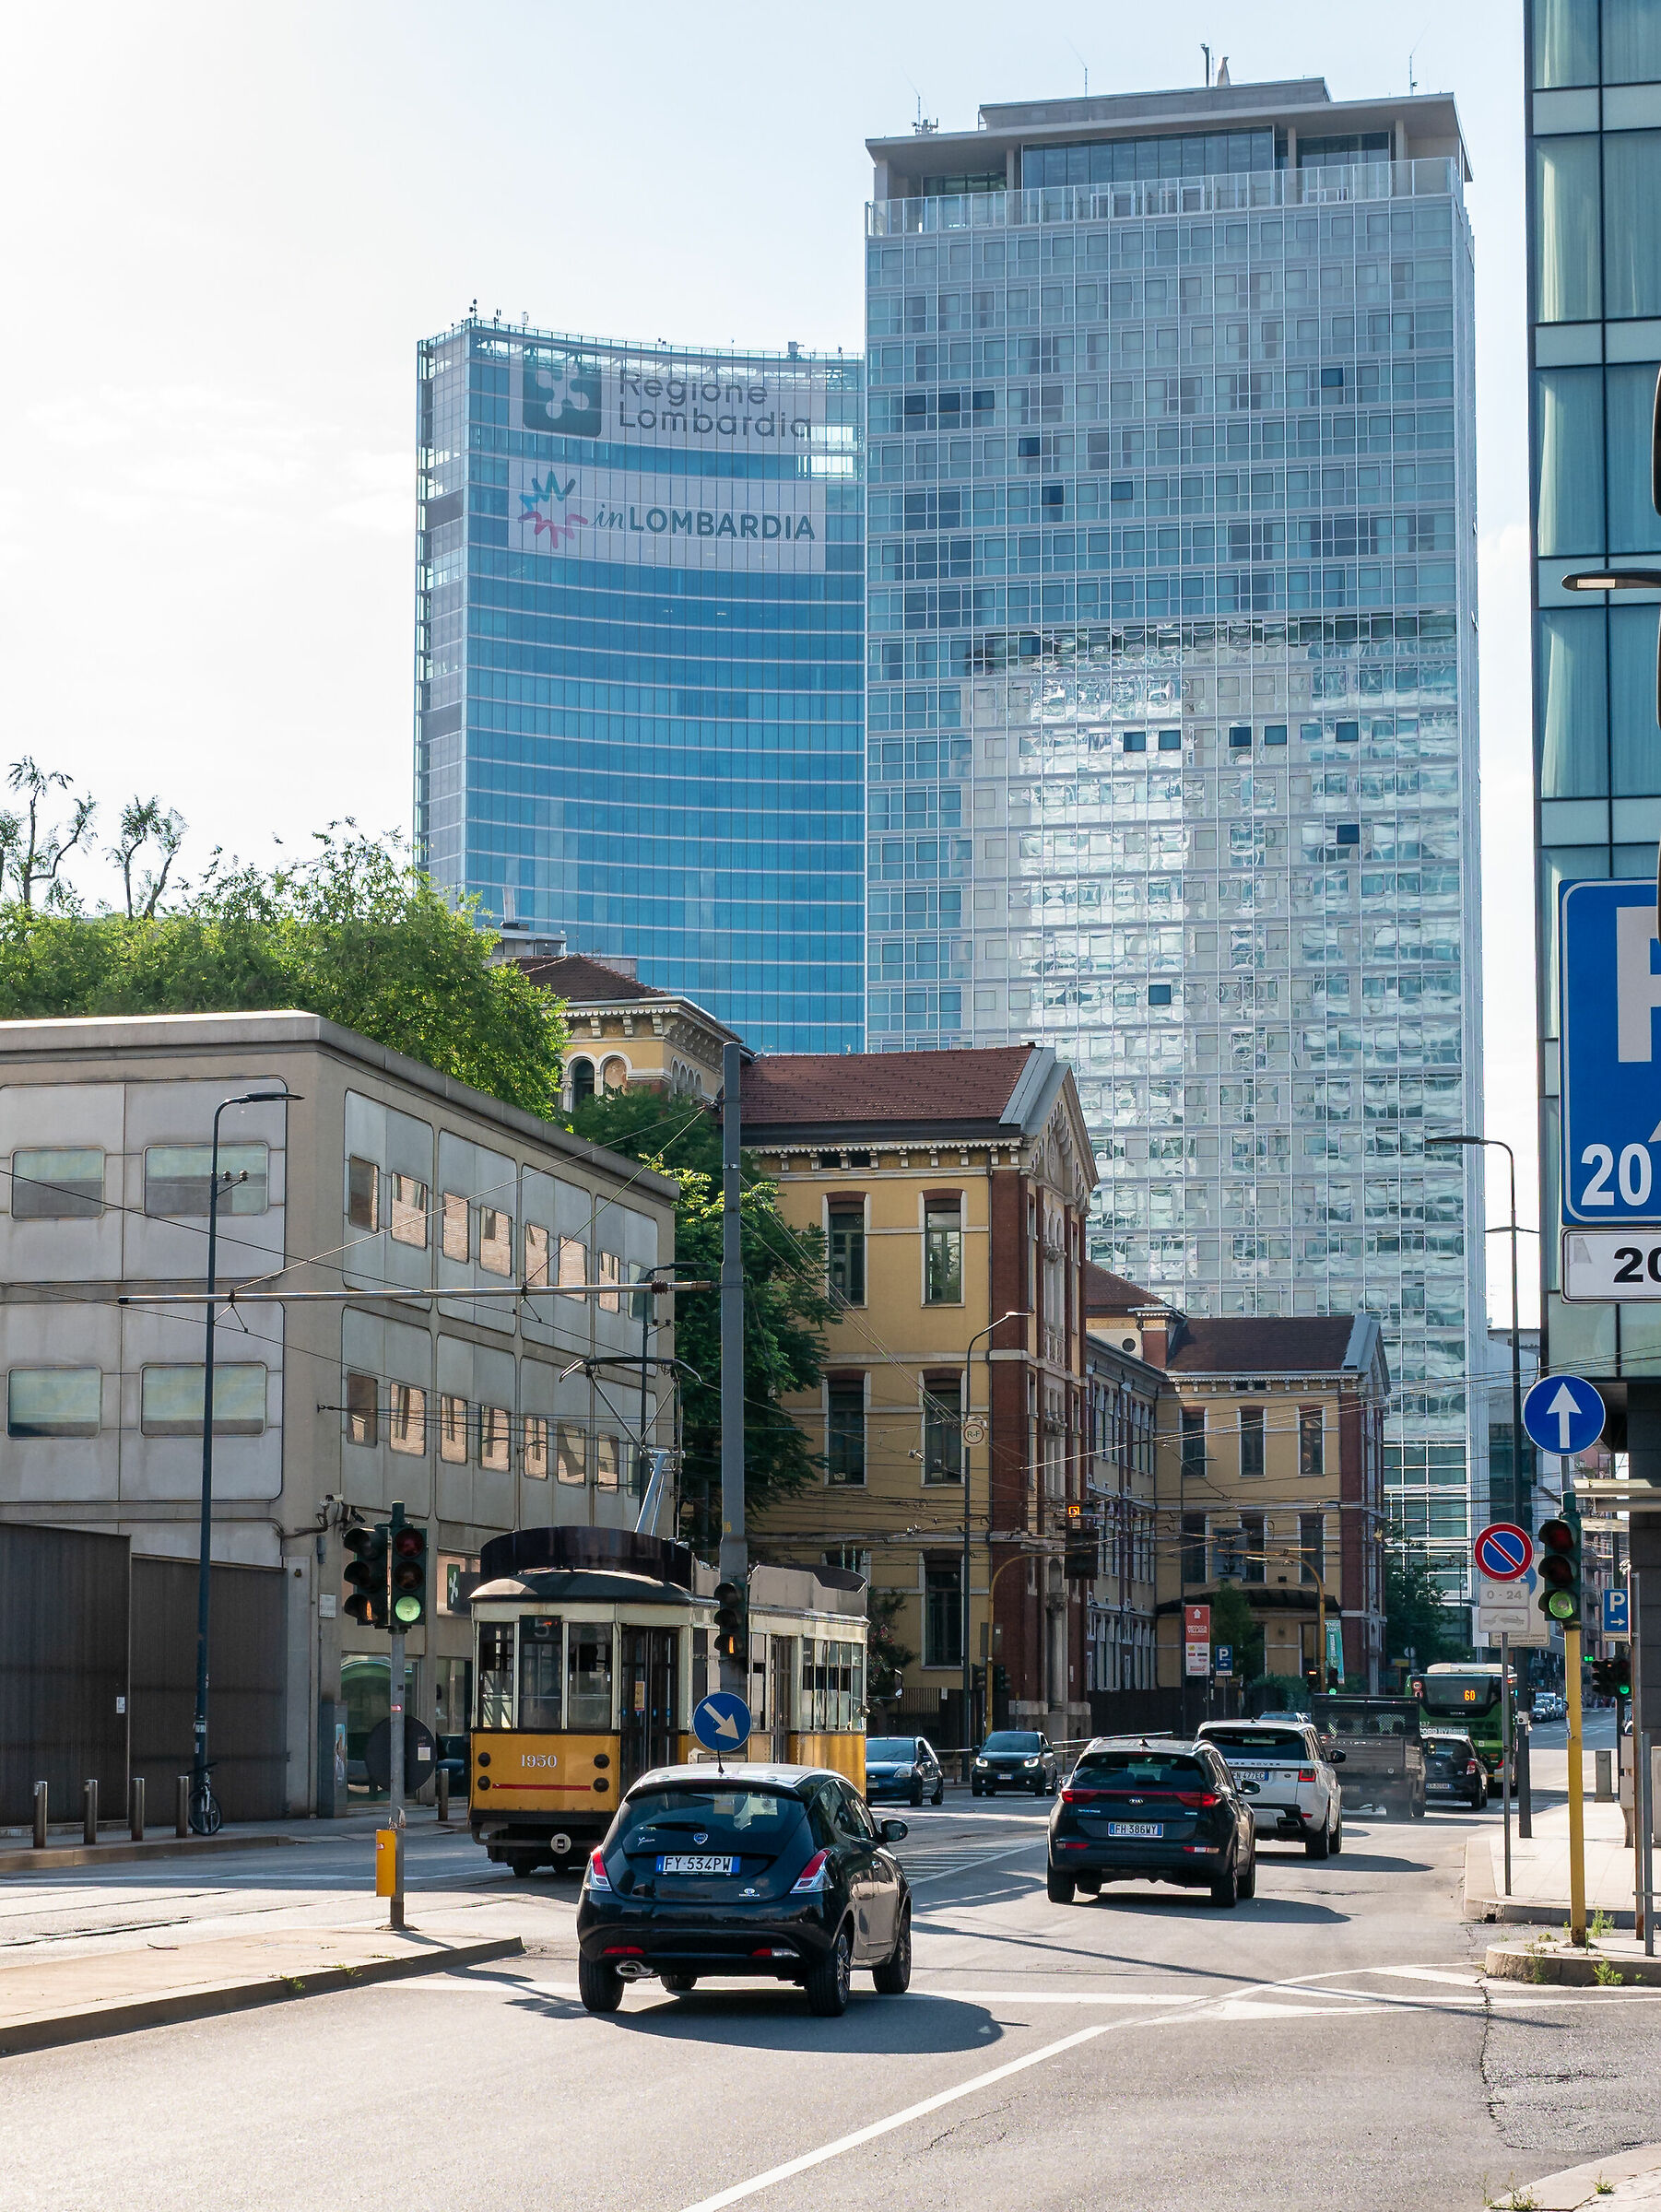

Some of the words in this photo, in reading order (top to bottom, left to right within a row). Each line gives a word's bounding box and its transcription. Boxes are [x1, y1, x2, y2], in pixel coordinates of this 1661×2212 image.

[618, 369, 769, 407] Regione
[618, 400, 812, 439] Lombardia
[591, 504, 816, 541] inLOMBARDIA
[1580, 1142, 1653, 1207] 20
[1506, 1590, 1523, 1600] 24
[1609, 1592, 1626, 1613] P
[1219, 1648, 1230, 1661] P
[1464, 1689, 1476, 1701] 60
[521, 1754, 558, 1768] 1950
[665, 1856, 683, 1871] FY
[687, 1857, 732, 1871] 534PW
